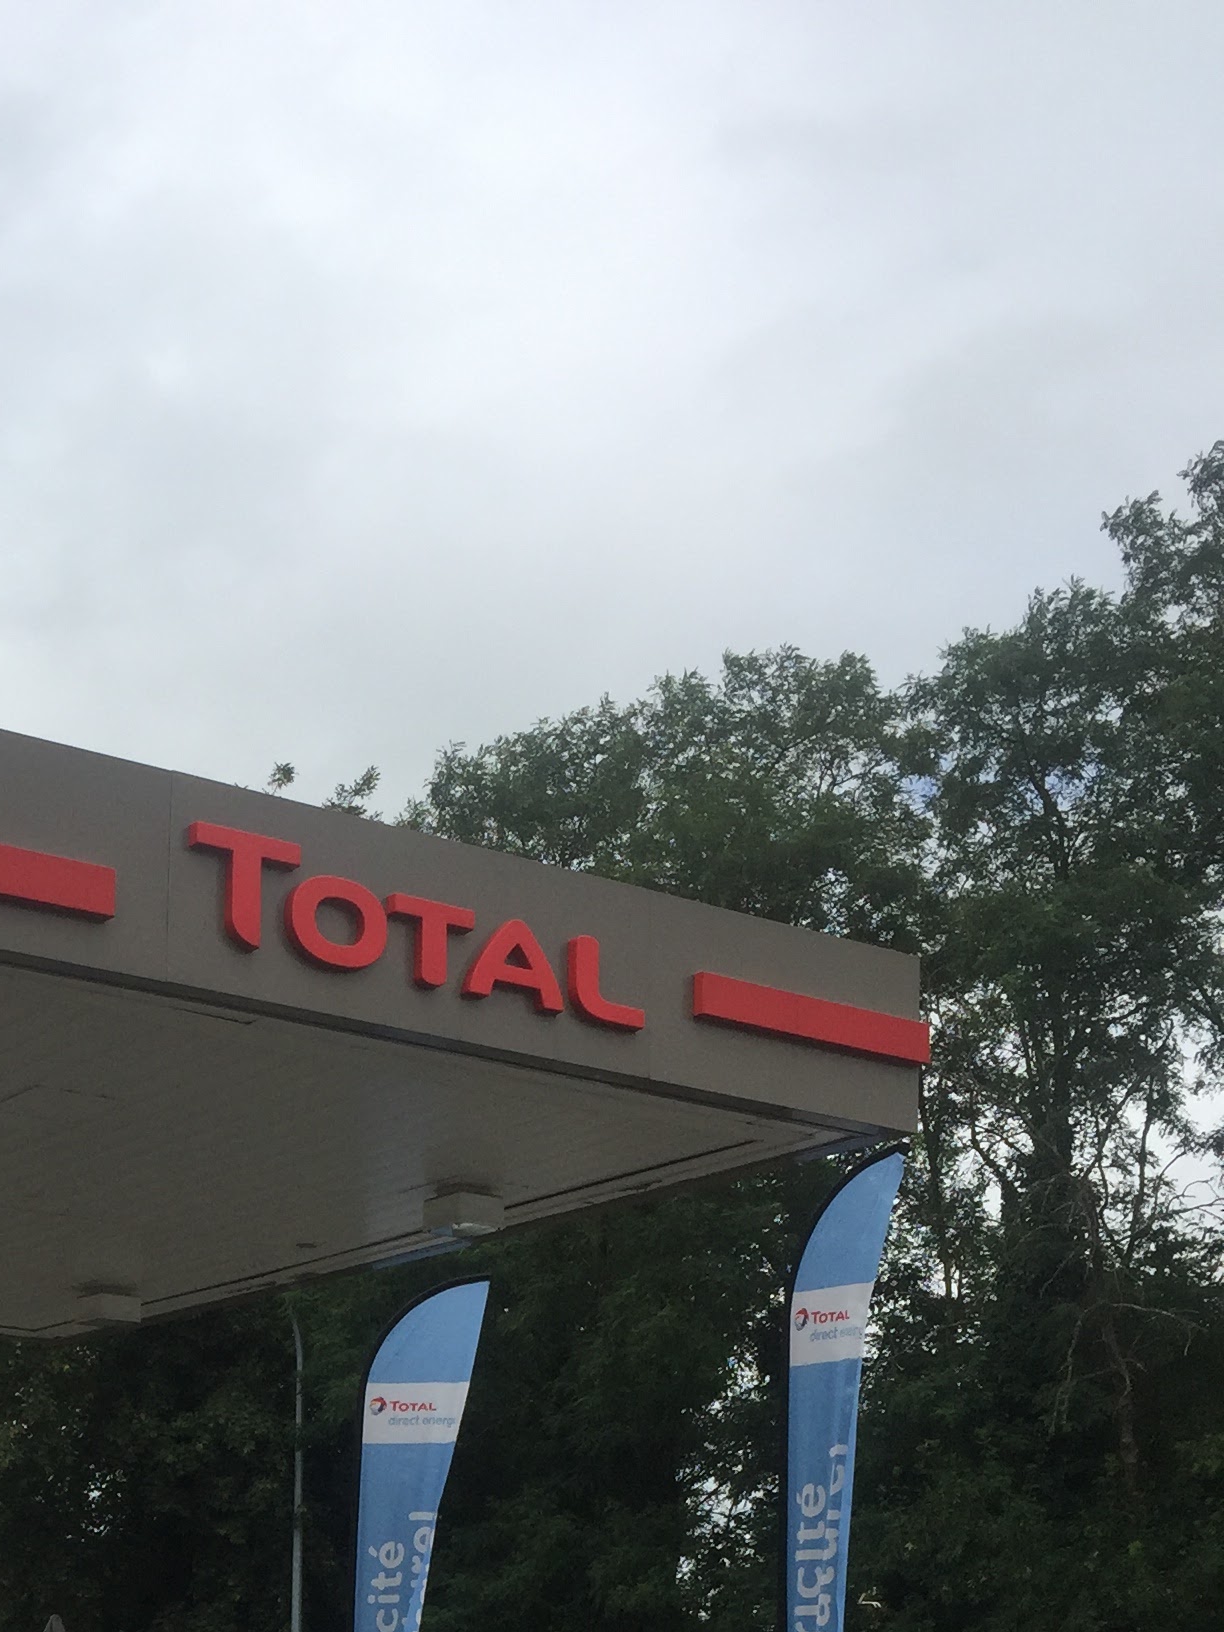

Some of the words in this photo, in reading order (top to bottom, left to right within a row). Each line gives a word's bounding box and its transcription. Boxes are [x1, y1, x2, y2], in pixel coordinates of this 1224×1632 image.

[188, 820, 646, 1033] TOTAL
[810, 1309, 850, 1325] TOTAL
[389, 1400, 437, 1413] TOTAL
[388, 1415, 420, 1427] direct
